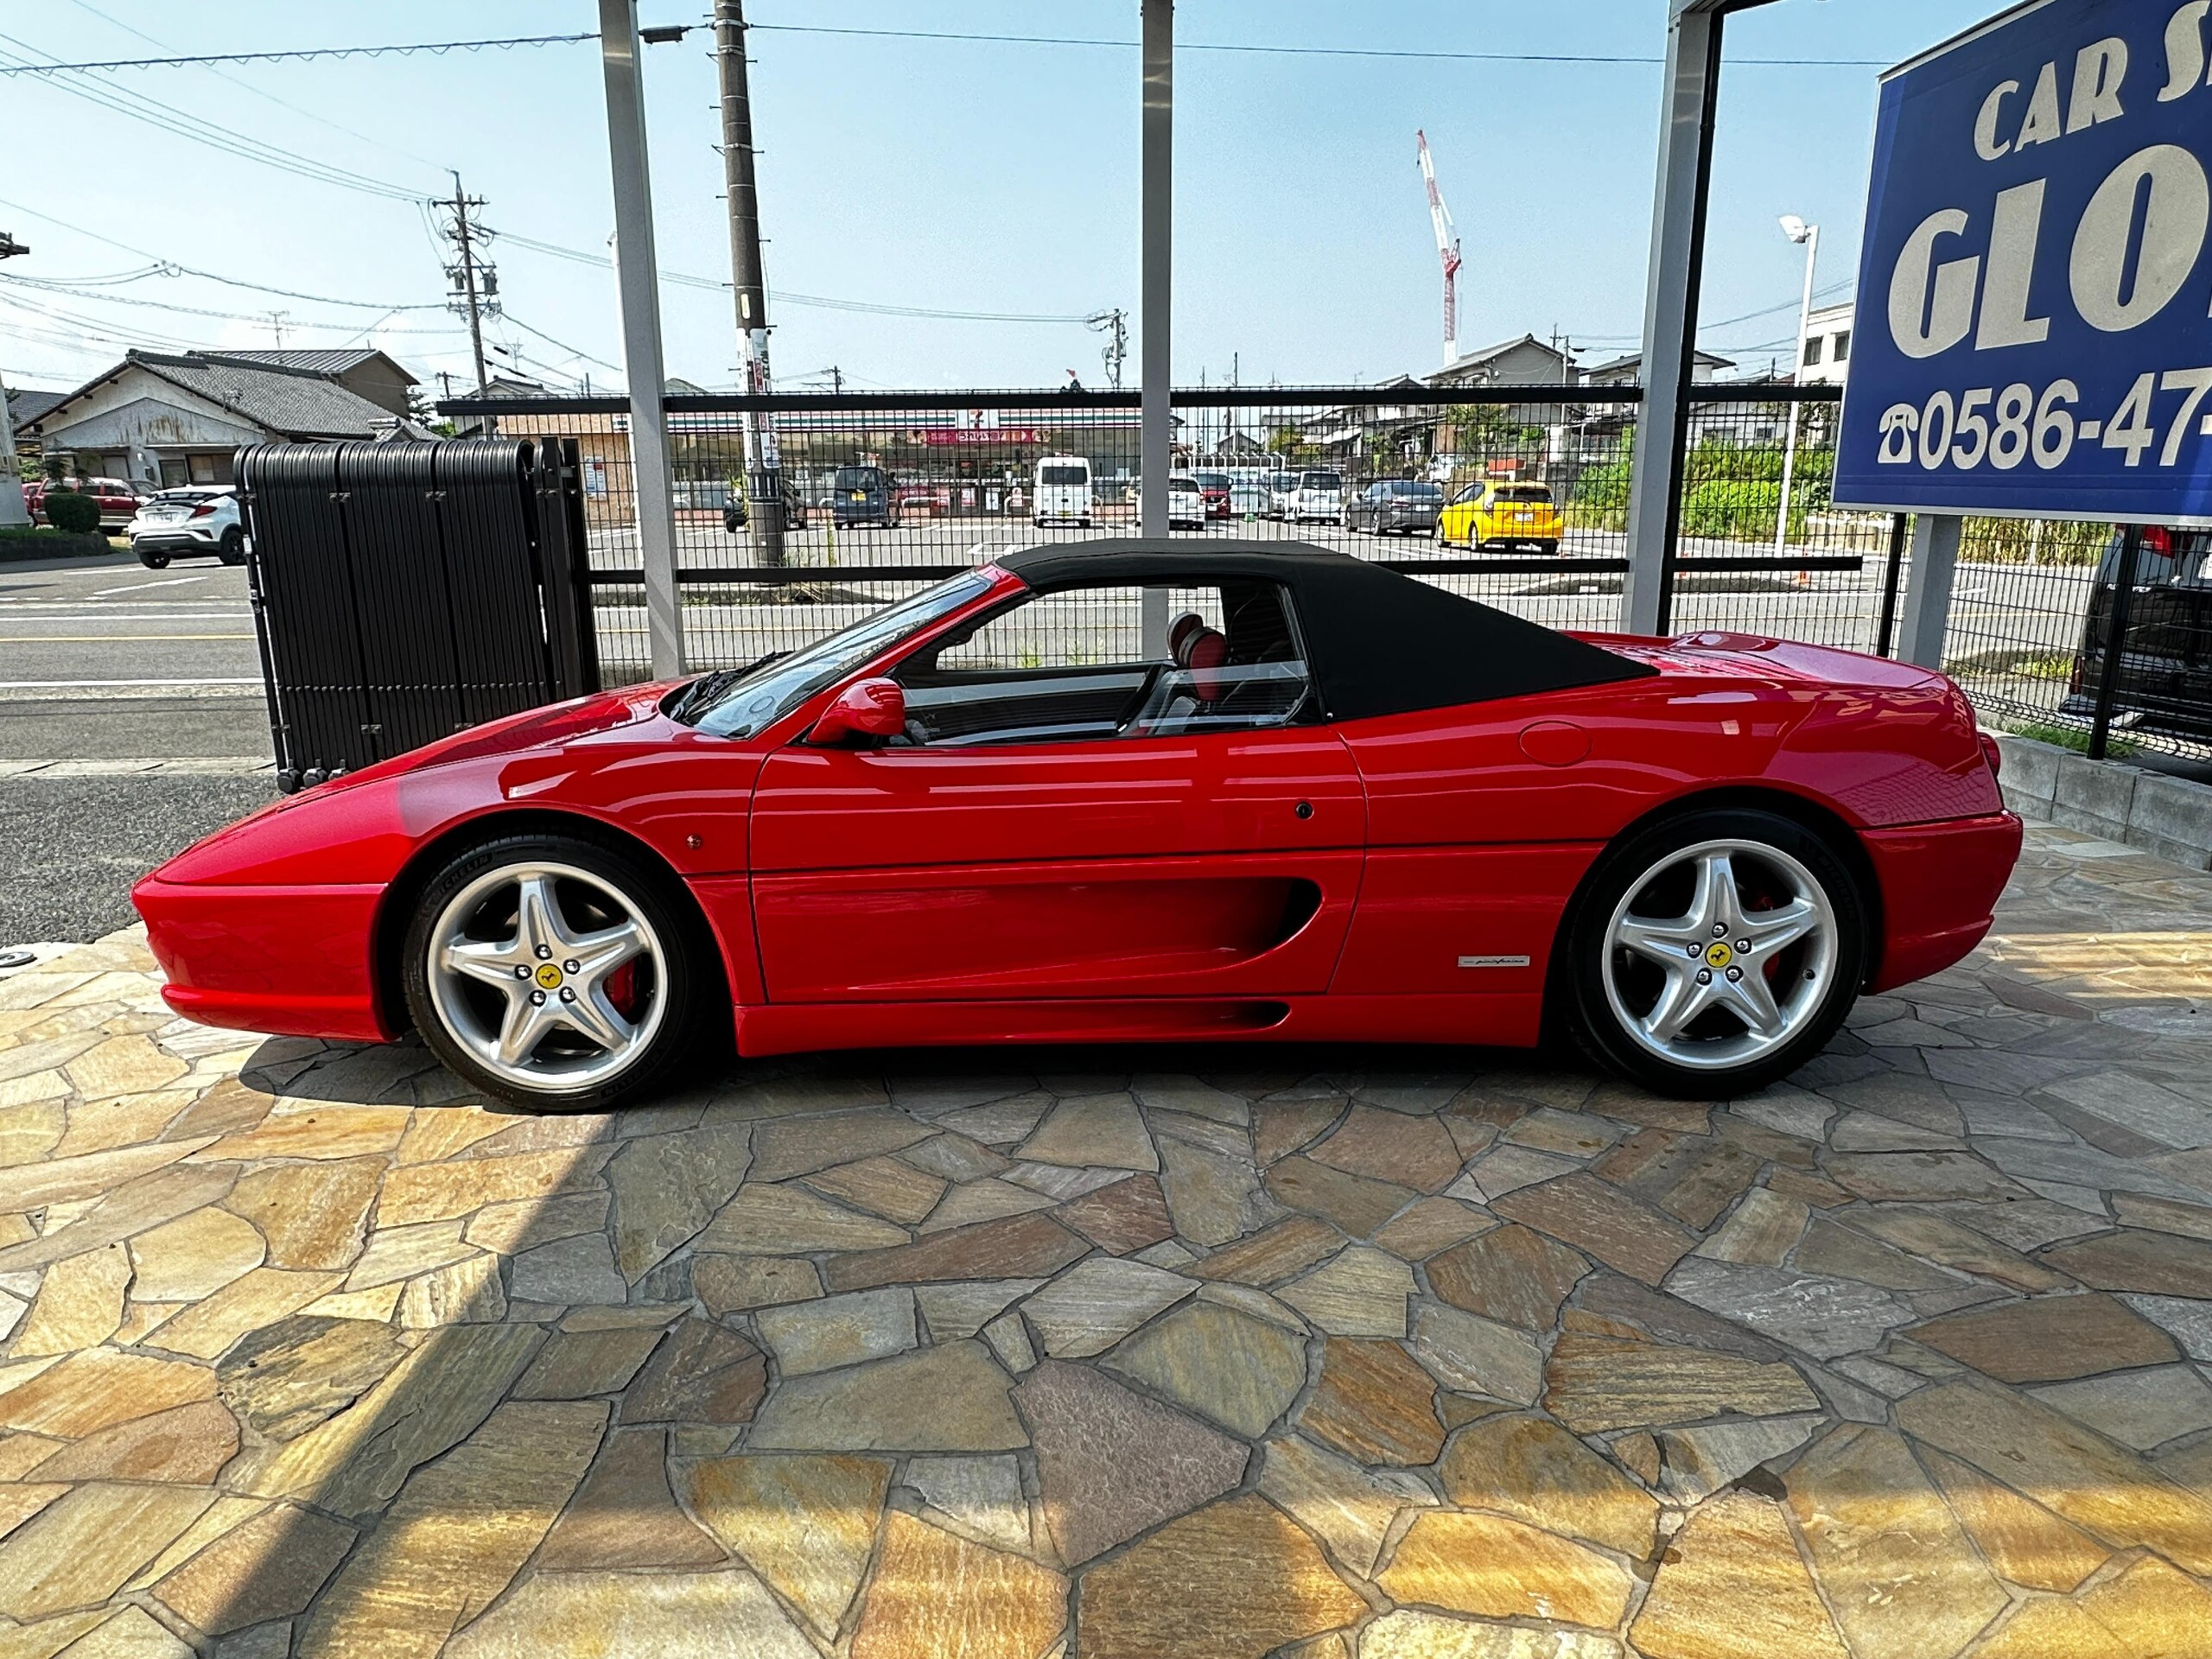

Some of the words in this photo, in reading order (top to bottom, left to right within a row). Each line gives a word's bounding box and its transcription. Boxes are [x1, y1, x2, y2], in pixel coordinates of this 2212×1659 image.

[1974, 37, 2128, 161] CAR
[2158, 0, 2212, 102] S
[1887, 144, 2212, 358] GLO
